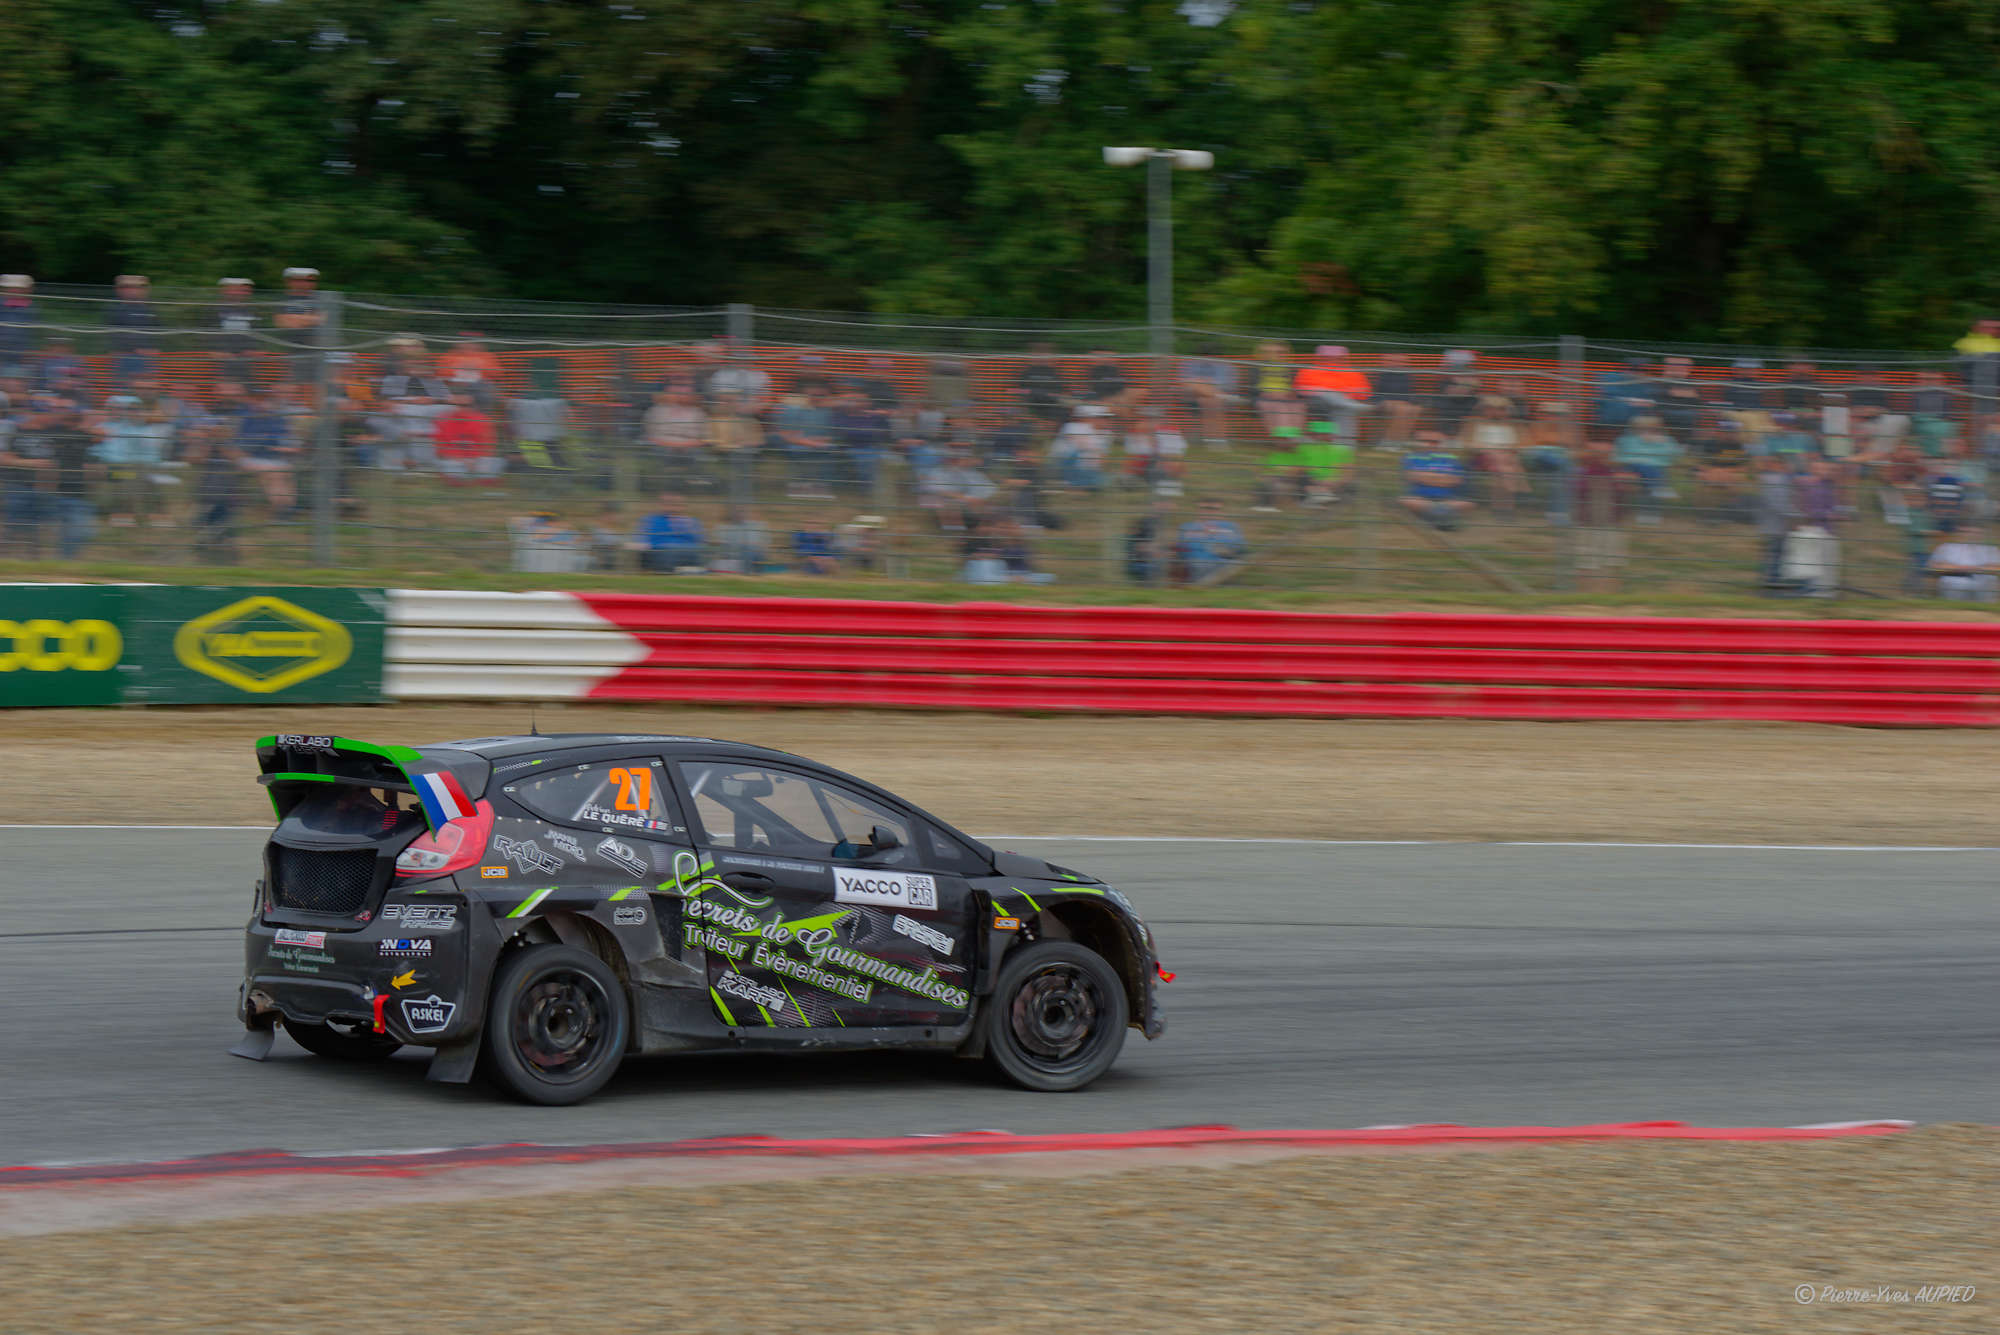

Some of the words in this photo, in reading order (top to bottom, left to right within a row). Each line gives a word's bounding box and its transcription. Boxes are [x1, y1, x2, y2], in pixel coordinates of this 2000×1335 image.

[609, 767, 652, 811] 27
[583, 811, 599, 820] LE
[483, 868, 506, 876] JCB
[840, 877, 902, 896] YACCO
[906, 875, 931, 888] SUPER
[908, 888, 934, 906] CAR
[761, 912, 794, 945] de
[796, 928, 969, 1008] Gourmandises
[411, 1007, 445, 1022] ASKEL
